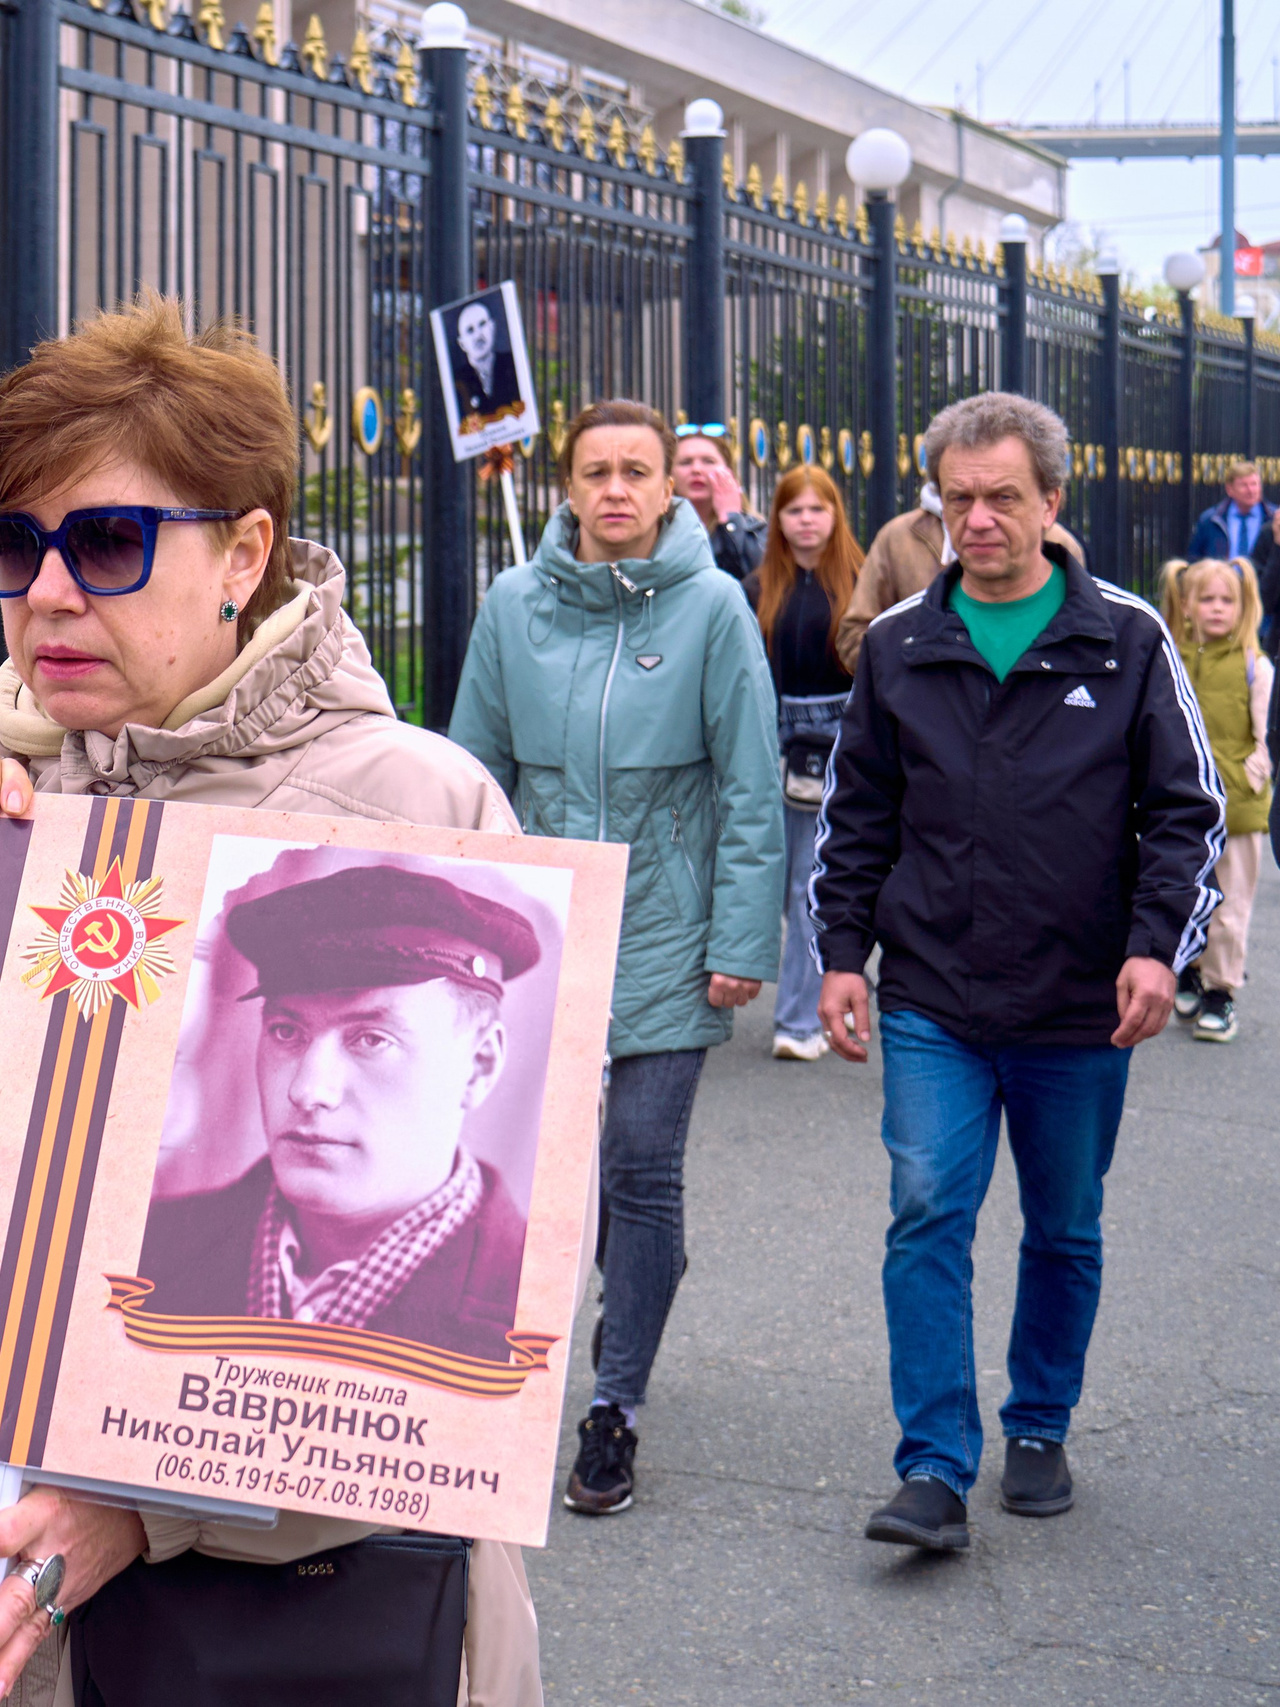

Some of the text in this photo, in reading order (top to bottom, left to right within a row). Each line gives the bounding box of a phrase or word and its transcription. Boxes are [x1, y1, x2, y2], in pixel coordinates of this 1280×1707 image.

[1064, 698, 1096, 708] adidas
[61, 899, 141, 970] ОТЕЧЕСТВЕННАЯ
[177, 1372, 429, 1447] Вавринюк
[214, 1355, 408, 1407] Труженик тыла
[101, 1405, 501, 1494] Николай Ульянович
[154, 1452, 430, 1523] (06.05.1915-07.08.1988)
[297, 1562, 335, 1576] BOSS
